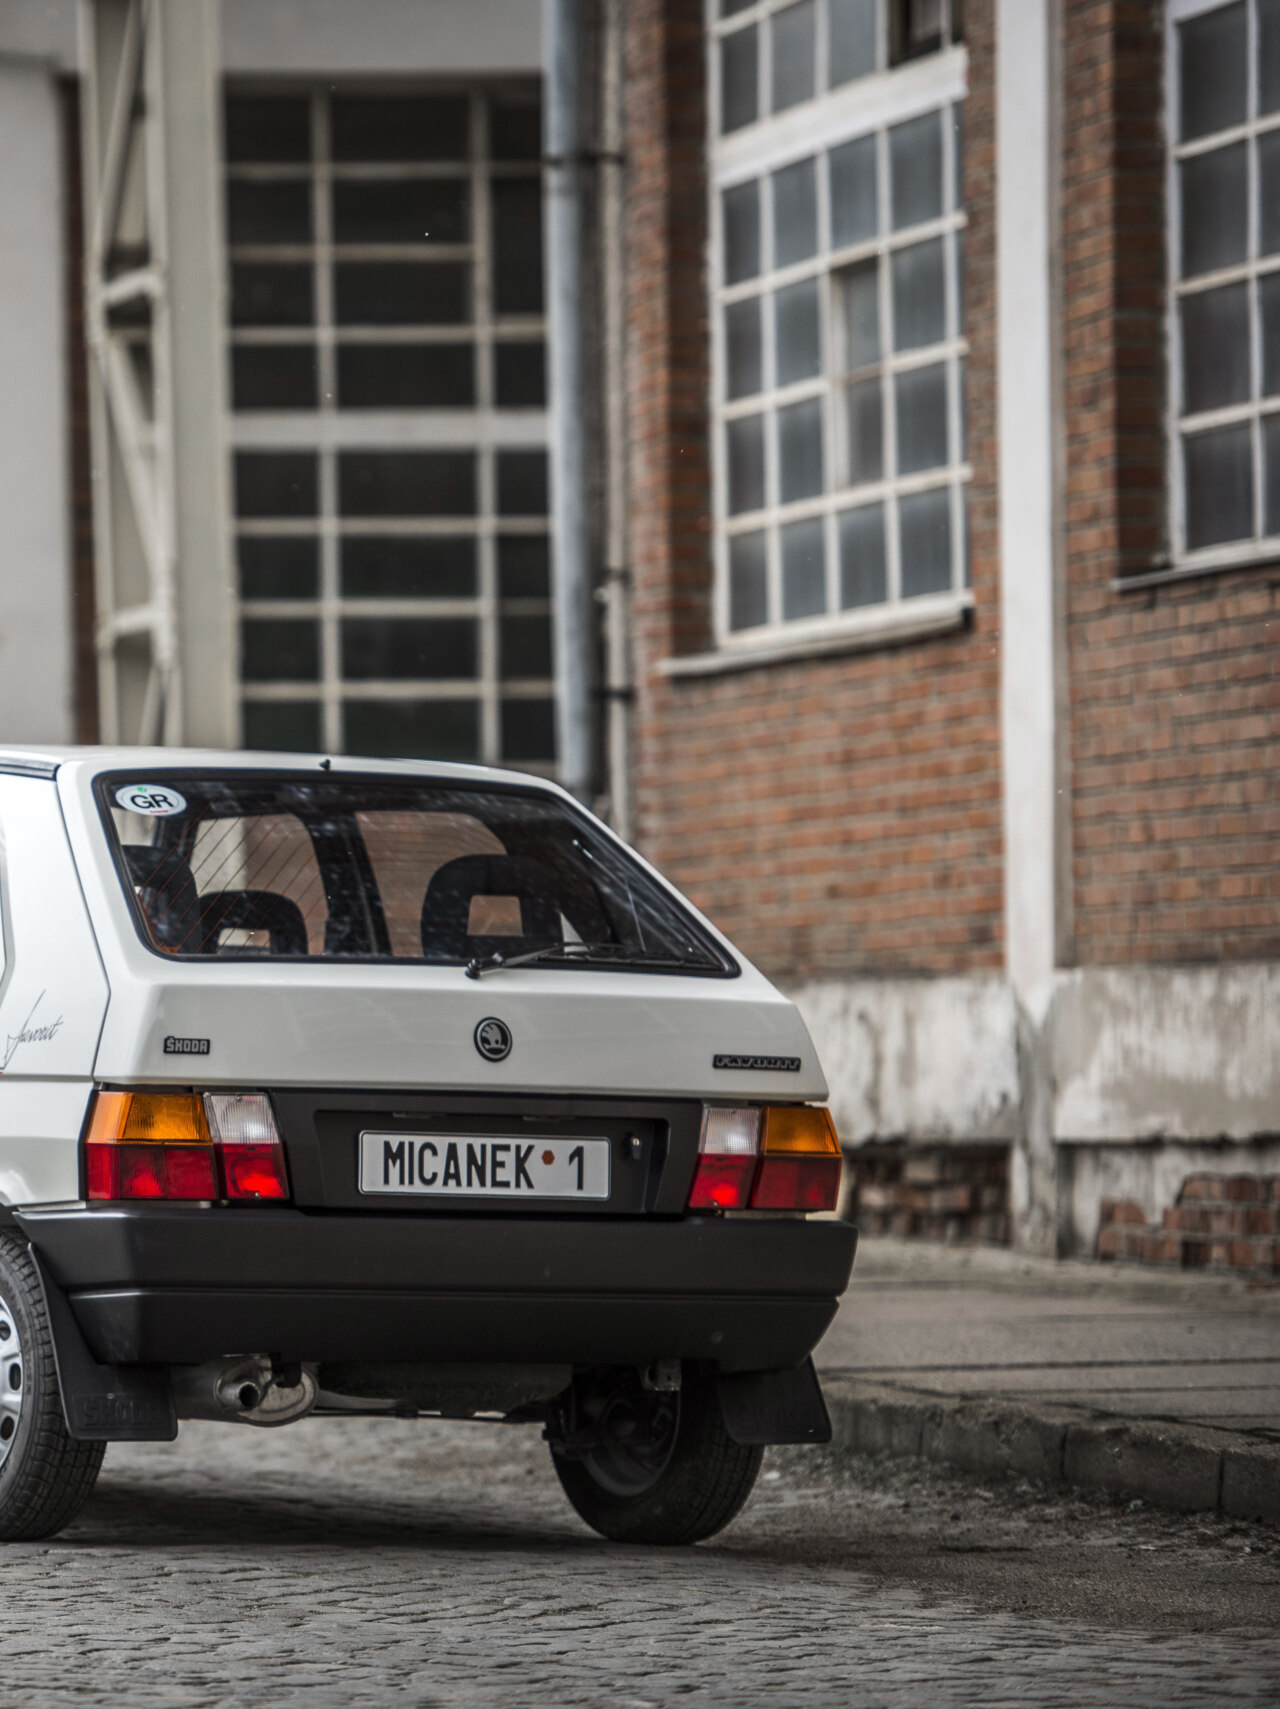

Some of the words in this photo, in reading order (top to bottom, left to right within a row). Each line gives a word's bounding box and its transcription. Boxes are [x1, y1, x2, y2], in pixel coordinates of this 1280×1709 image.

[130, 794, 174, 809] GR
[382, 1140, 536, 1190] MICANEK
[567, 1145, 585, 1192] 1
